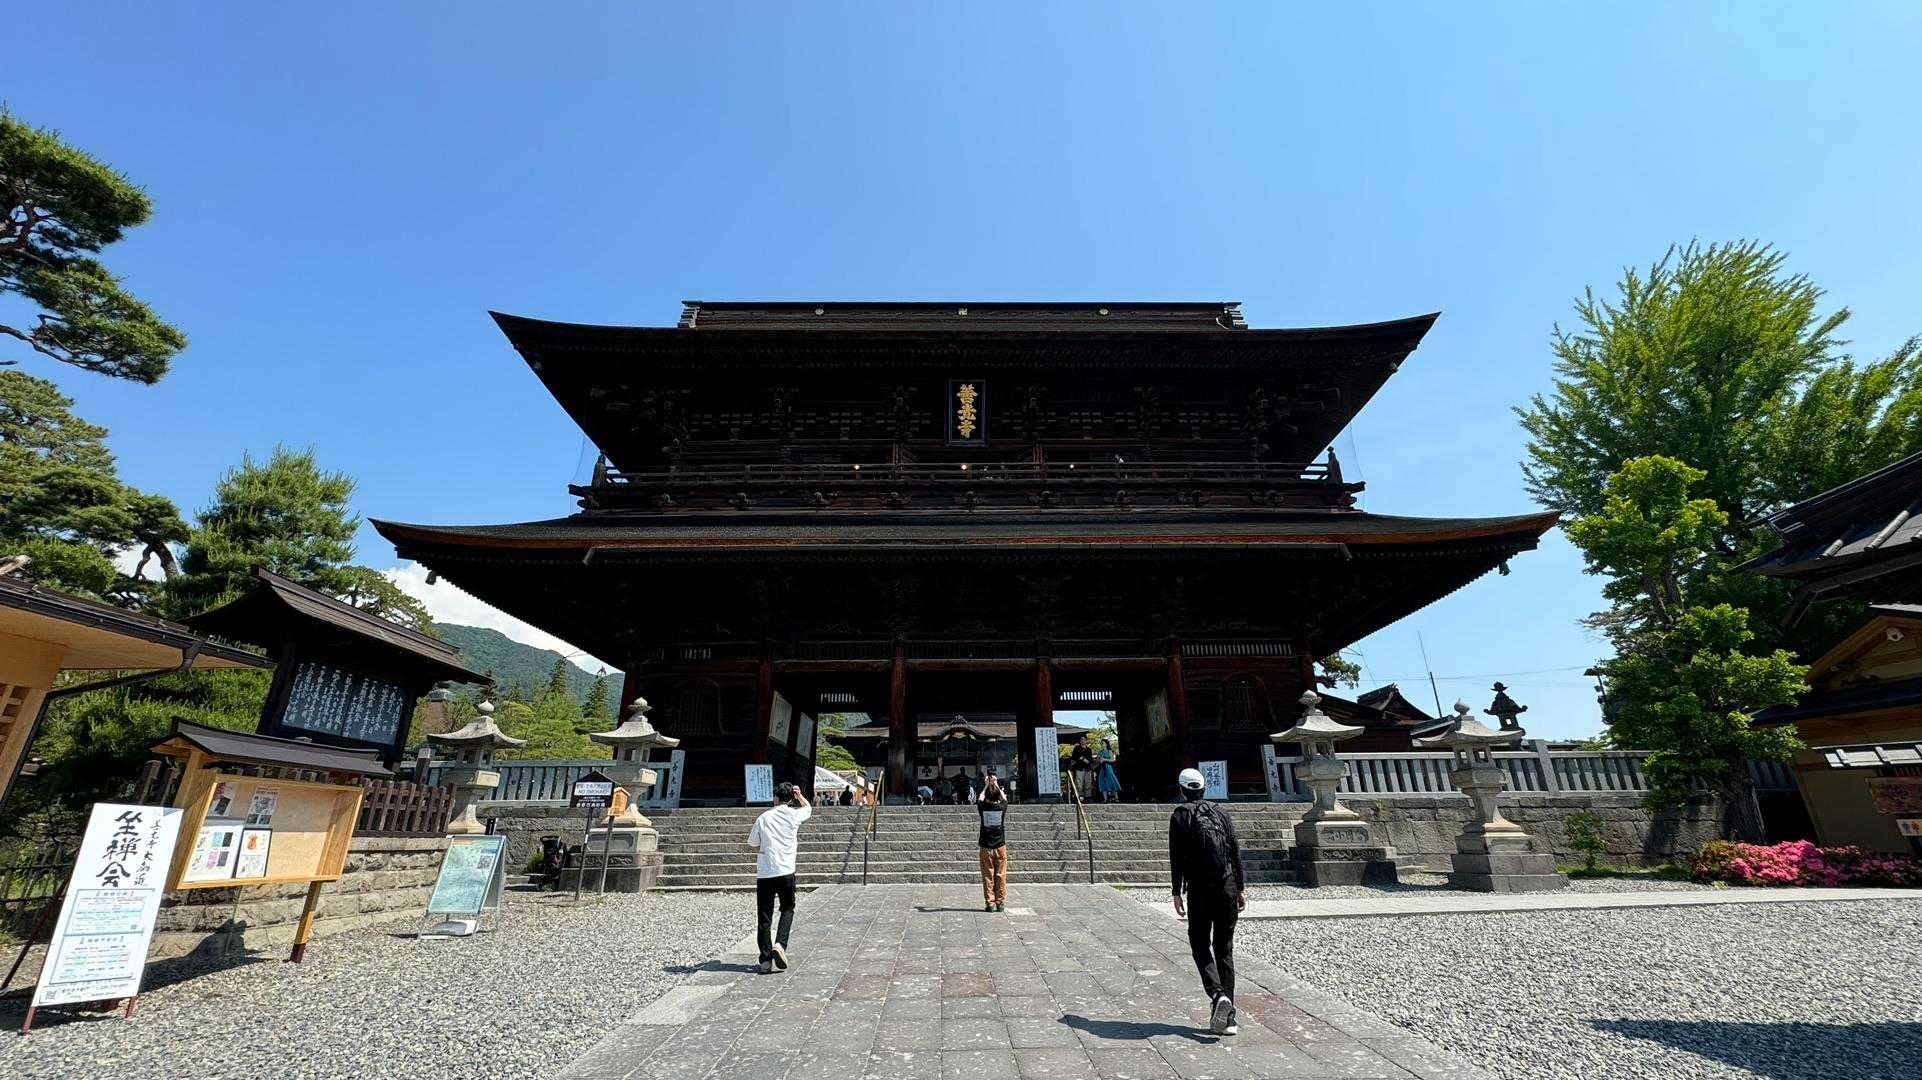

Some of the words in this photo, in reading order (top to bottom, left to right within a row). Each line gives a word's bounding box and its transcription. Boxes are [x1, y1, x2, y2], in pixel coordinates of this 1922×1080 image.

[956, 384, 978, 438] 善光寺
[96, 810, 143, 888] 坐禅会
